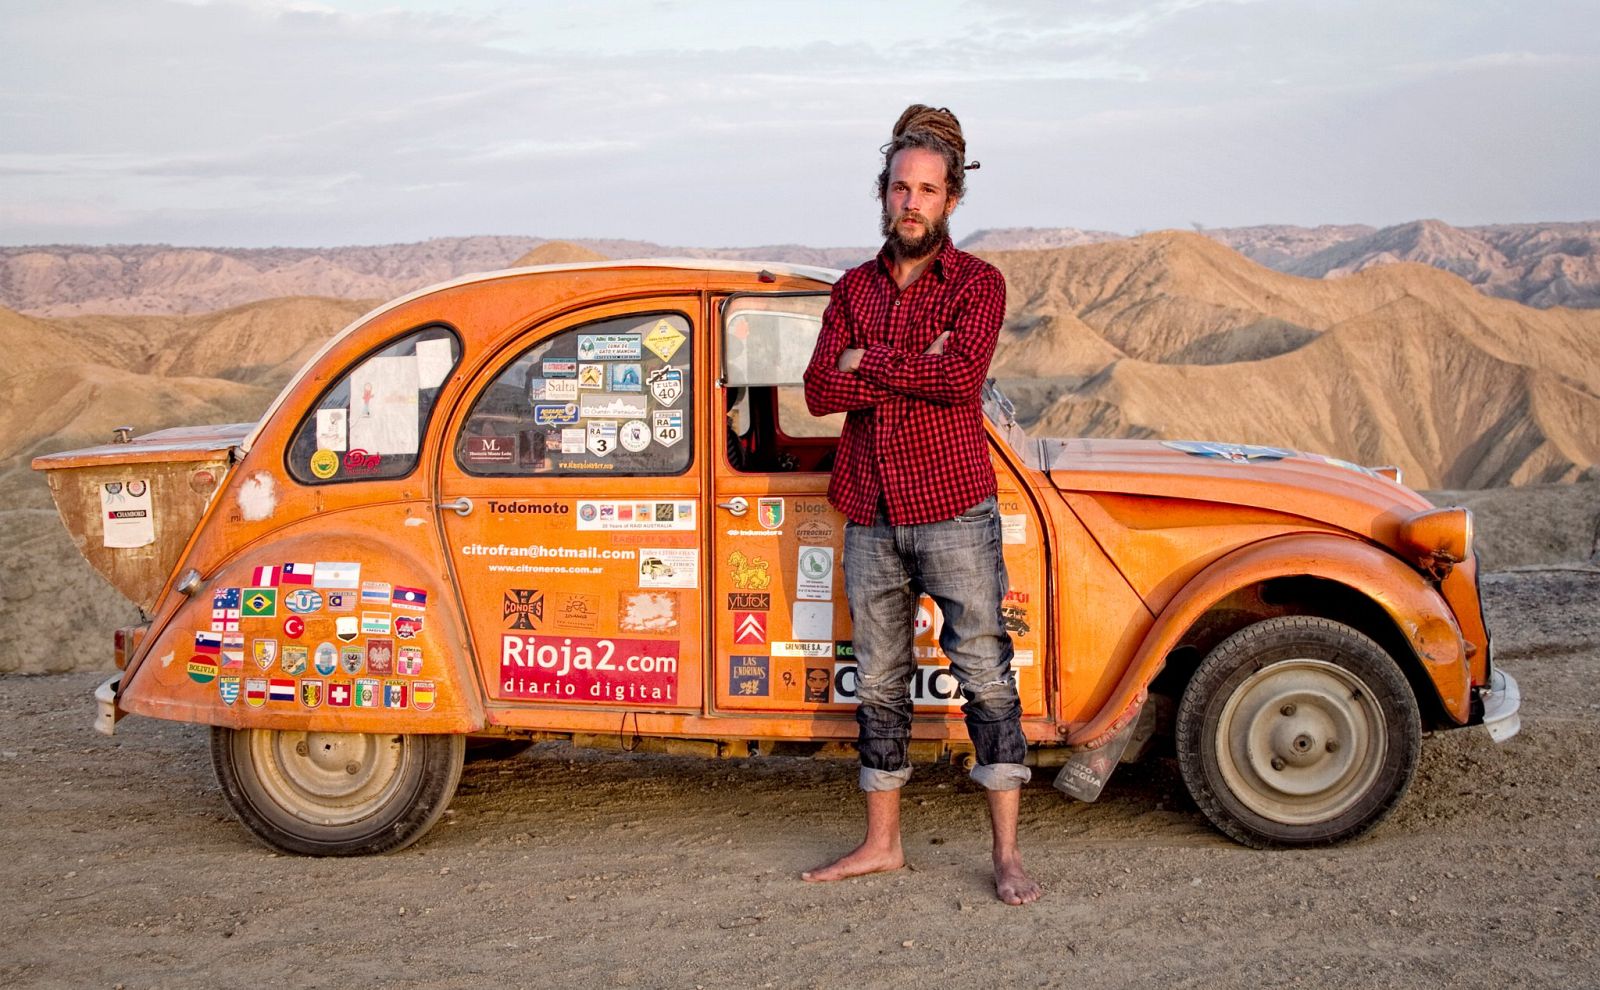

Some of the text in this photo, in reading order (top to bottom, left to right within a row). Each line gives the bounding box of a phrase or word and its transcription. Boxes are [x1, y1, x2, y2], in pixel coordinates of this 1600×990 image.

[548, 380, 576, 392] Salta
[658, 388, 676, 399] 40
[659, 428, 677, 440] 40
[481, 439, 500, 451] ML
[596, 439, 607, 452] 3
[488, 501, 569, 514] Todomoto
[116, 510, 146, 518] CHAMBORD
[462, 544, 636, 560] citrofran@hotmail.com
[488, 563, 603, 574] www.citroneros.com.ar
[504, 600, 542, 615] CONDE'S
[785, 643, 811, 651] GRENOBLE
[503, 635, 677, 676] Rioja2.com
[742, 657, 757, 666] LAS
[188, 664, 215, 675] BOLIVIA
[504, 678, 672, 700] diario digital
